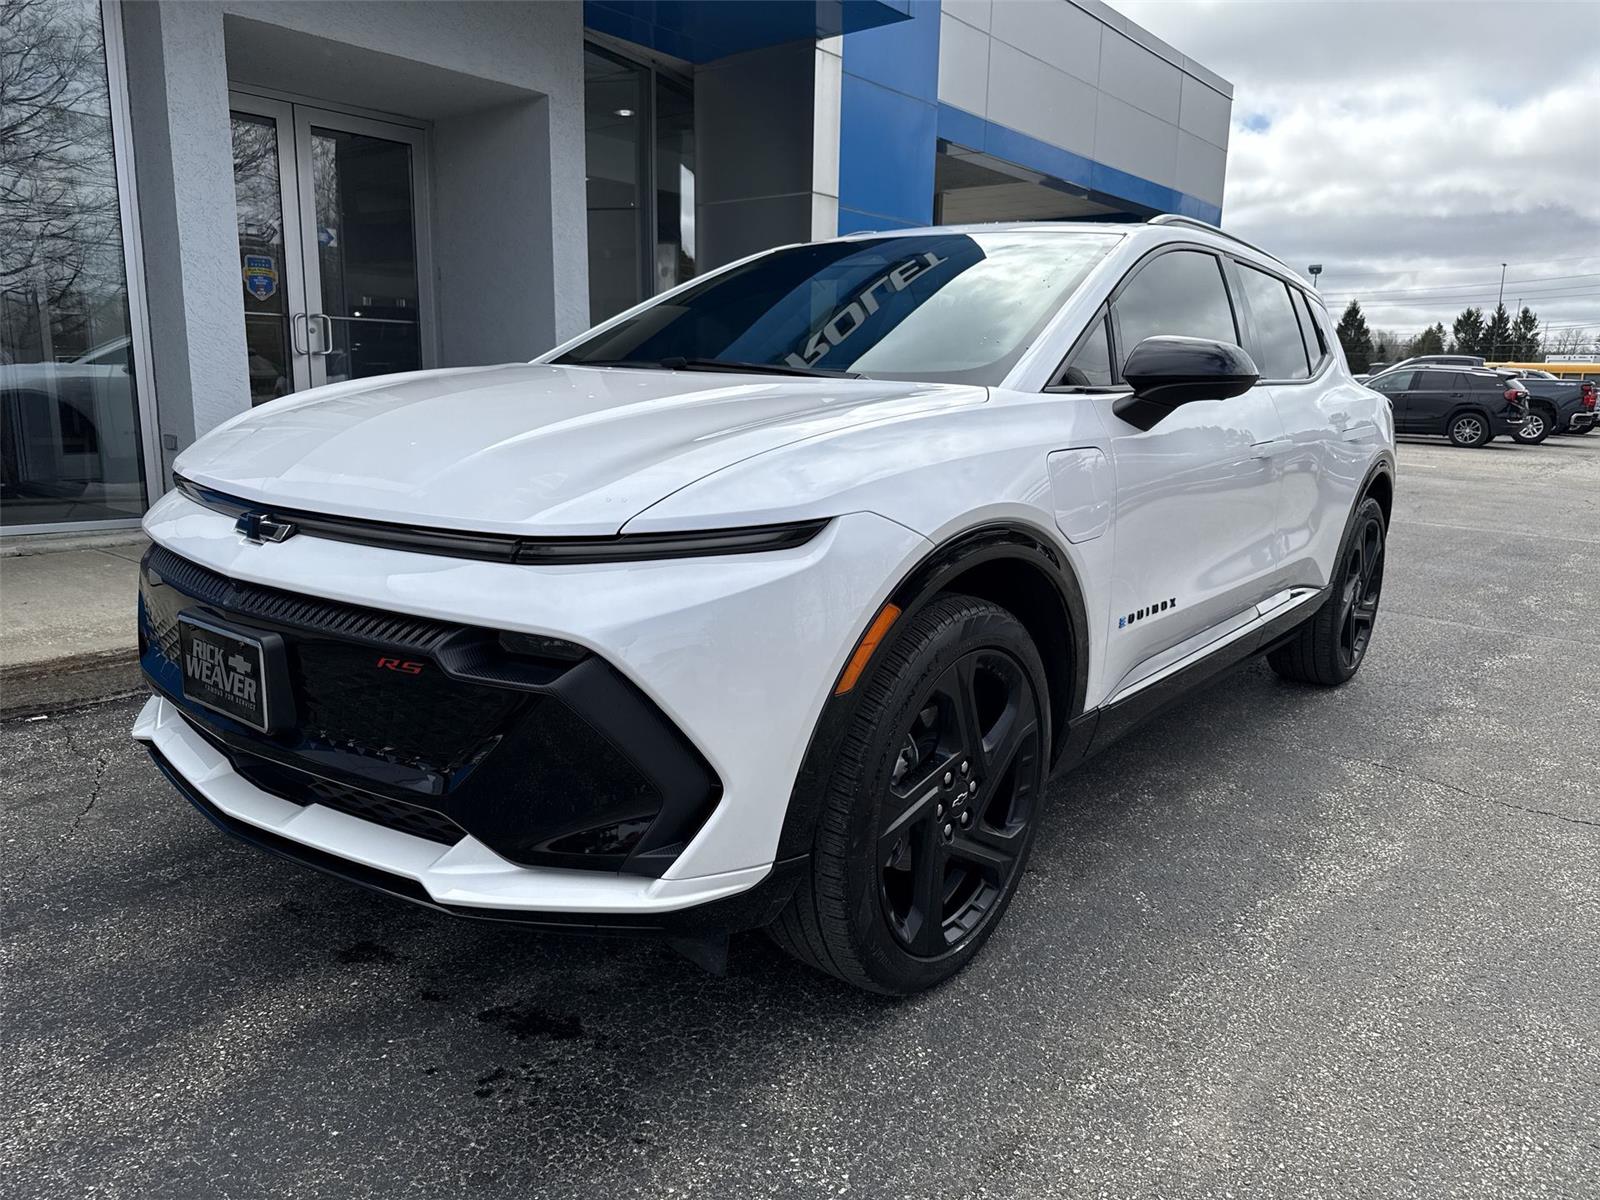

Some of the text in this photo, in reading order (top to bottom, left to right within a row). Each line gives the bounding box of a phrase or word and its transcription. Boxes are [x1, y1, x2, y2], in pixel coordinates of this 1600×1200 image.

[1118, 597, 1177, 629] EQUINOX
[193, 639, 224, 666] RICK
[377, 657, 424, 675] RS
[186, 654, 257, 703] WEAVER
